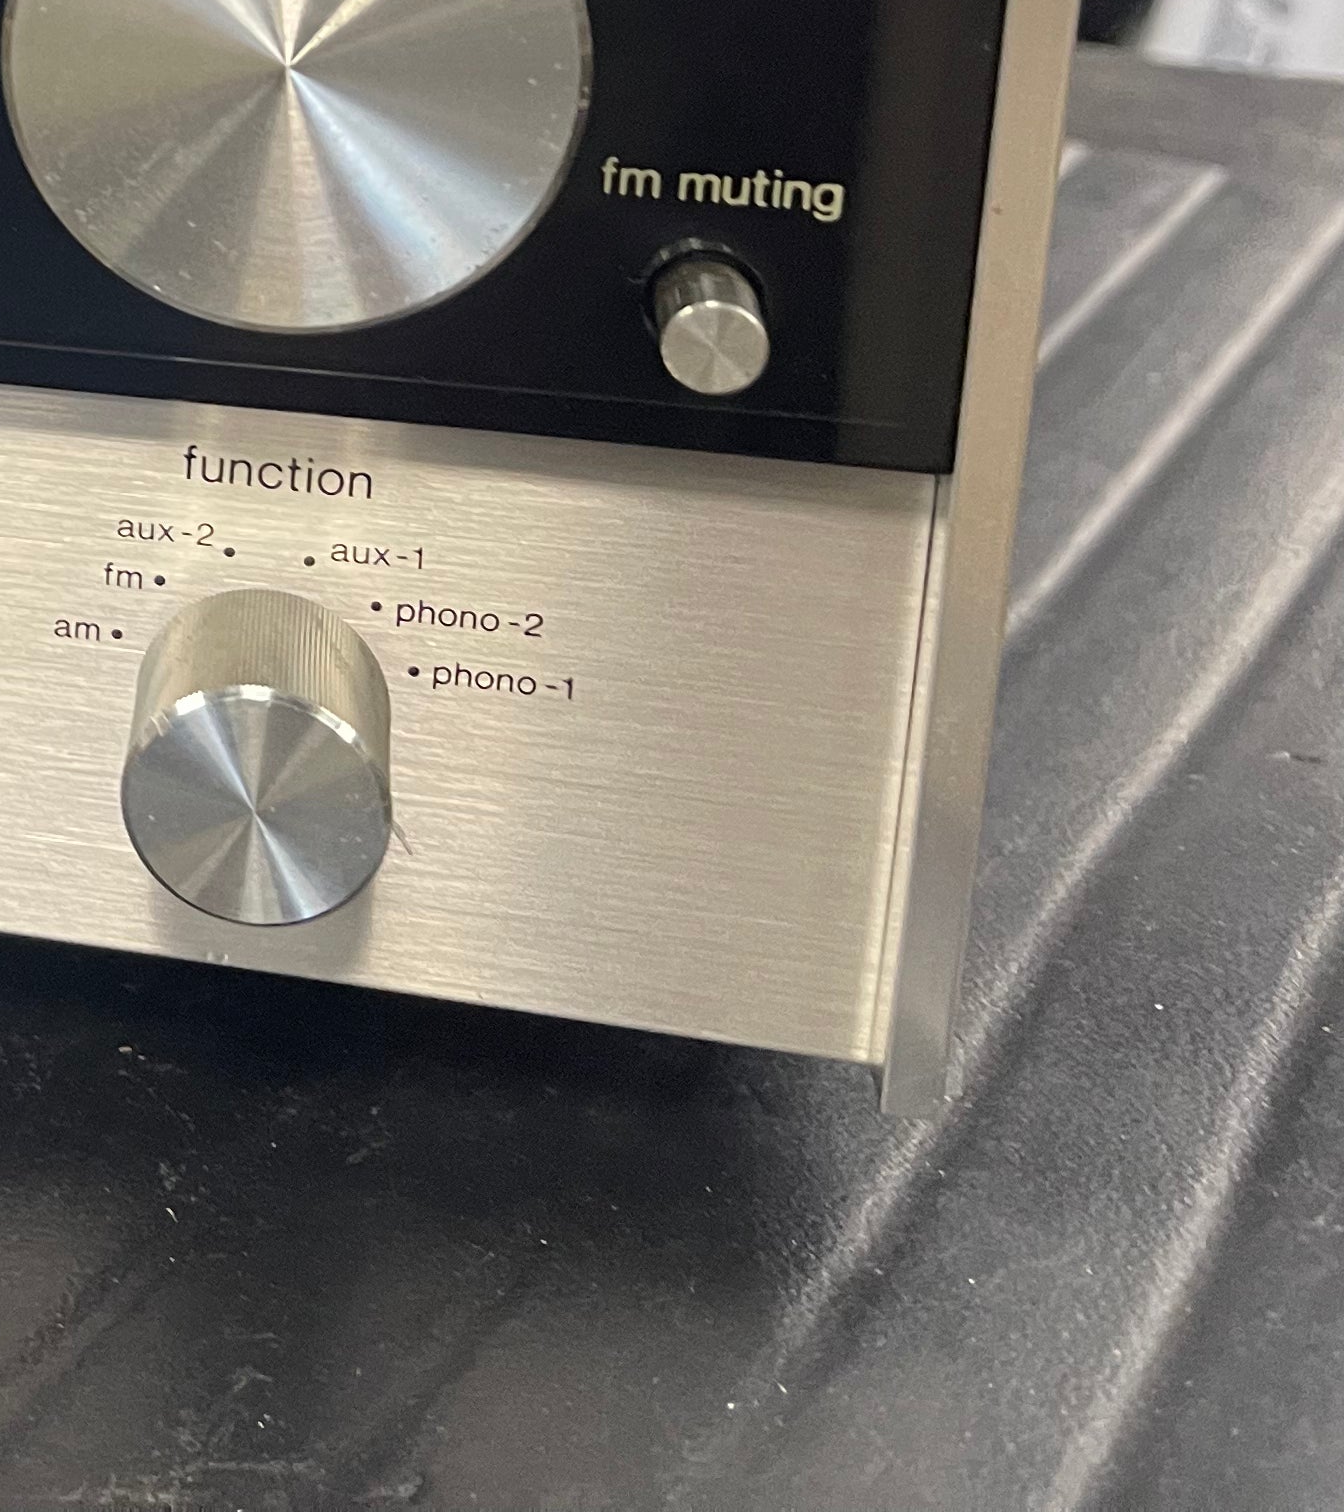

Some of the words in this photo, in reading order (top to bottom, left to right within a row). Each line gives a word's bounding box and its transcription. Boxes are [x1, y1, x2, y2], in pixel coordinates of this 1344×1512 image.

[601, 156, 662, 200] fm
[677, 169, 846, 222] muting
[183, 444, 374, 500] function
[116, 517, 216, 548] aux-2
[329, 540, 427, 571] aux-1
[103, 562, 144, 590] fm
[53, 618, 101, 642] am
[395, 597, 545, 639] phono-2
[431, 662, 576, 701] phono-1
